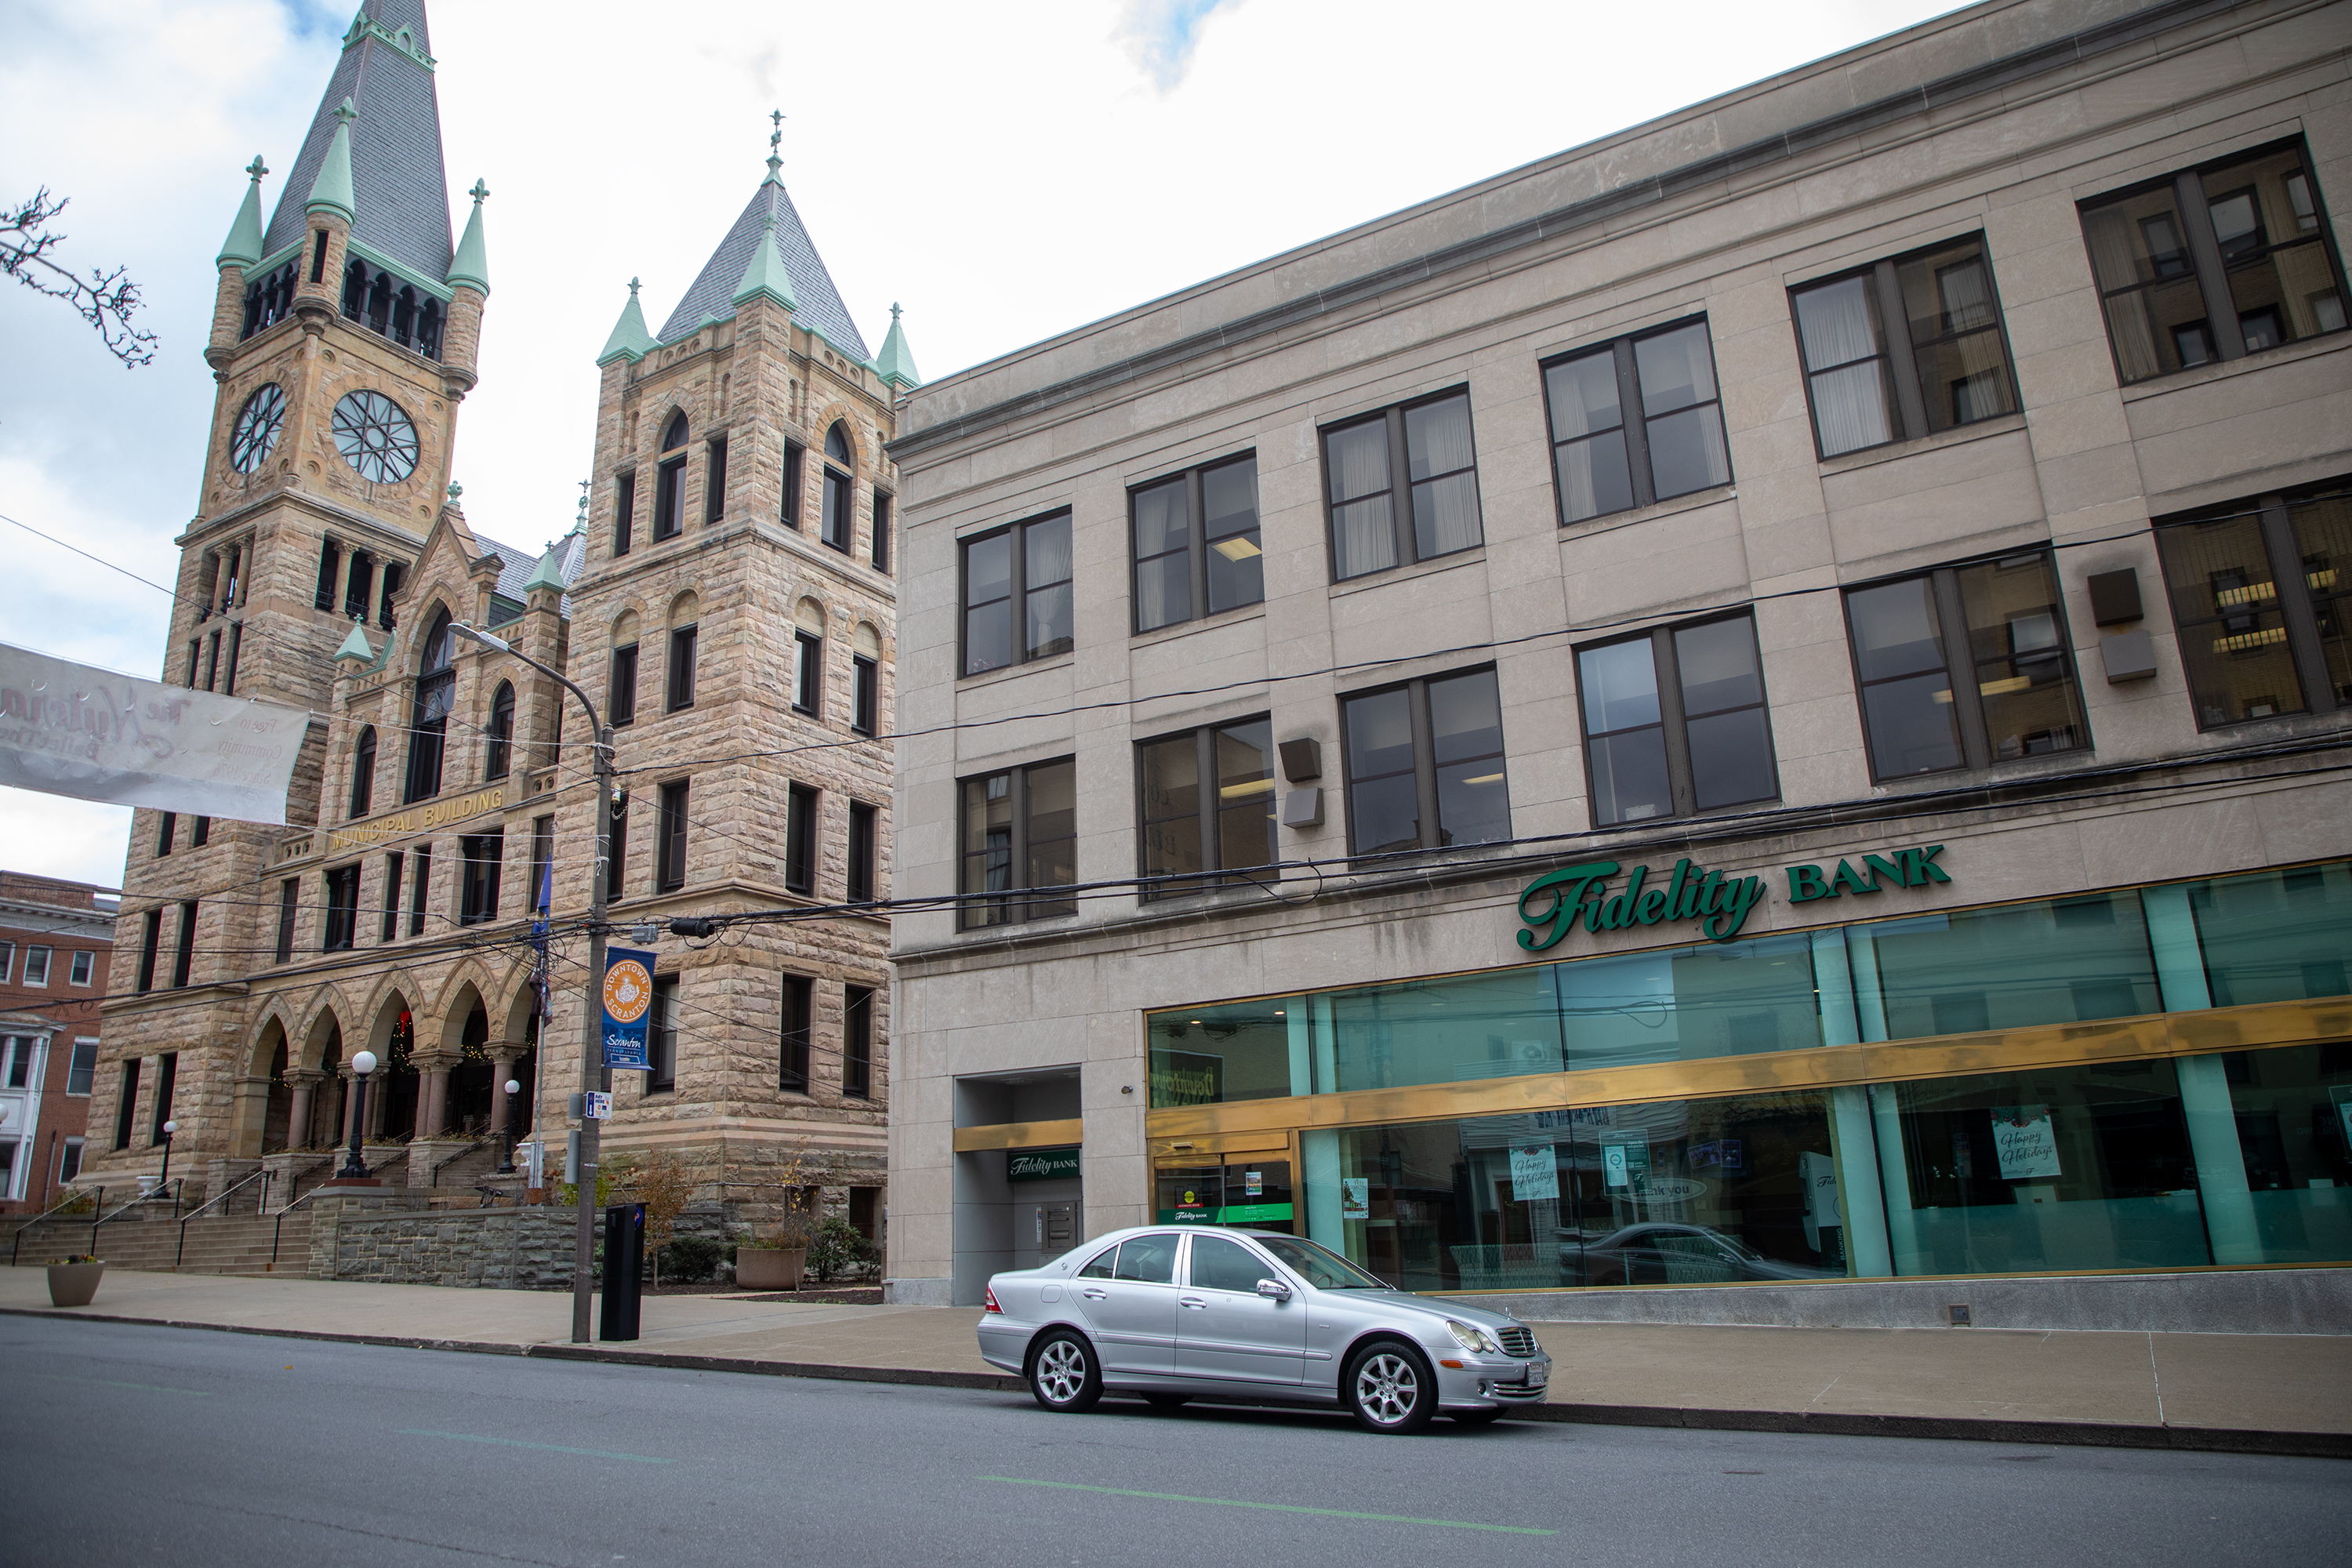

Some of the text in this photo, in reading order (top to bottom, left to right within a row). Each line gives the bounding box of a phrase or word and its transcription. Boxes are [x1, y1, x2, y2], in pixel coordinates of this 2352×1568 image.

[332, 789, 503, 851] MUNICIPAL BUILDING
[1516, 844, 1952, 952] Fidelity BANK
[606, 964, 648, 991] DOWNTOWN
[608, 991, 648, 1018] SCRANTON
[607, 1034, 641, 1048] Scranton
[2001, 1131, 2042, 1149] Happy
[2002, 1145, 2053, 1166] Holidays
[1011, 1157, 1078, 1175] Fidelity BANK
[1515, 1159, 1547, 1173] Happy
[1515, 1171, 1554, 1189] Holidays
[1668, 1185, 1690, 1197] you
[1175, 1211, 1196, 1221] Fidelity
[1836, 1228, 1846, 1261] BANKING
